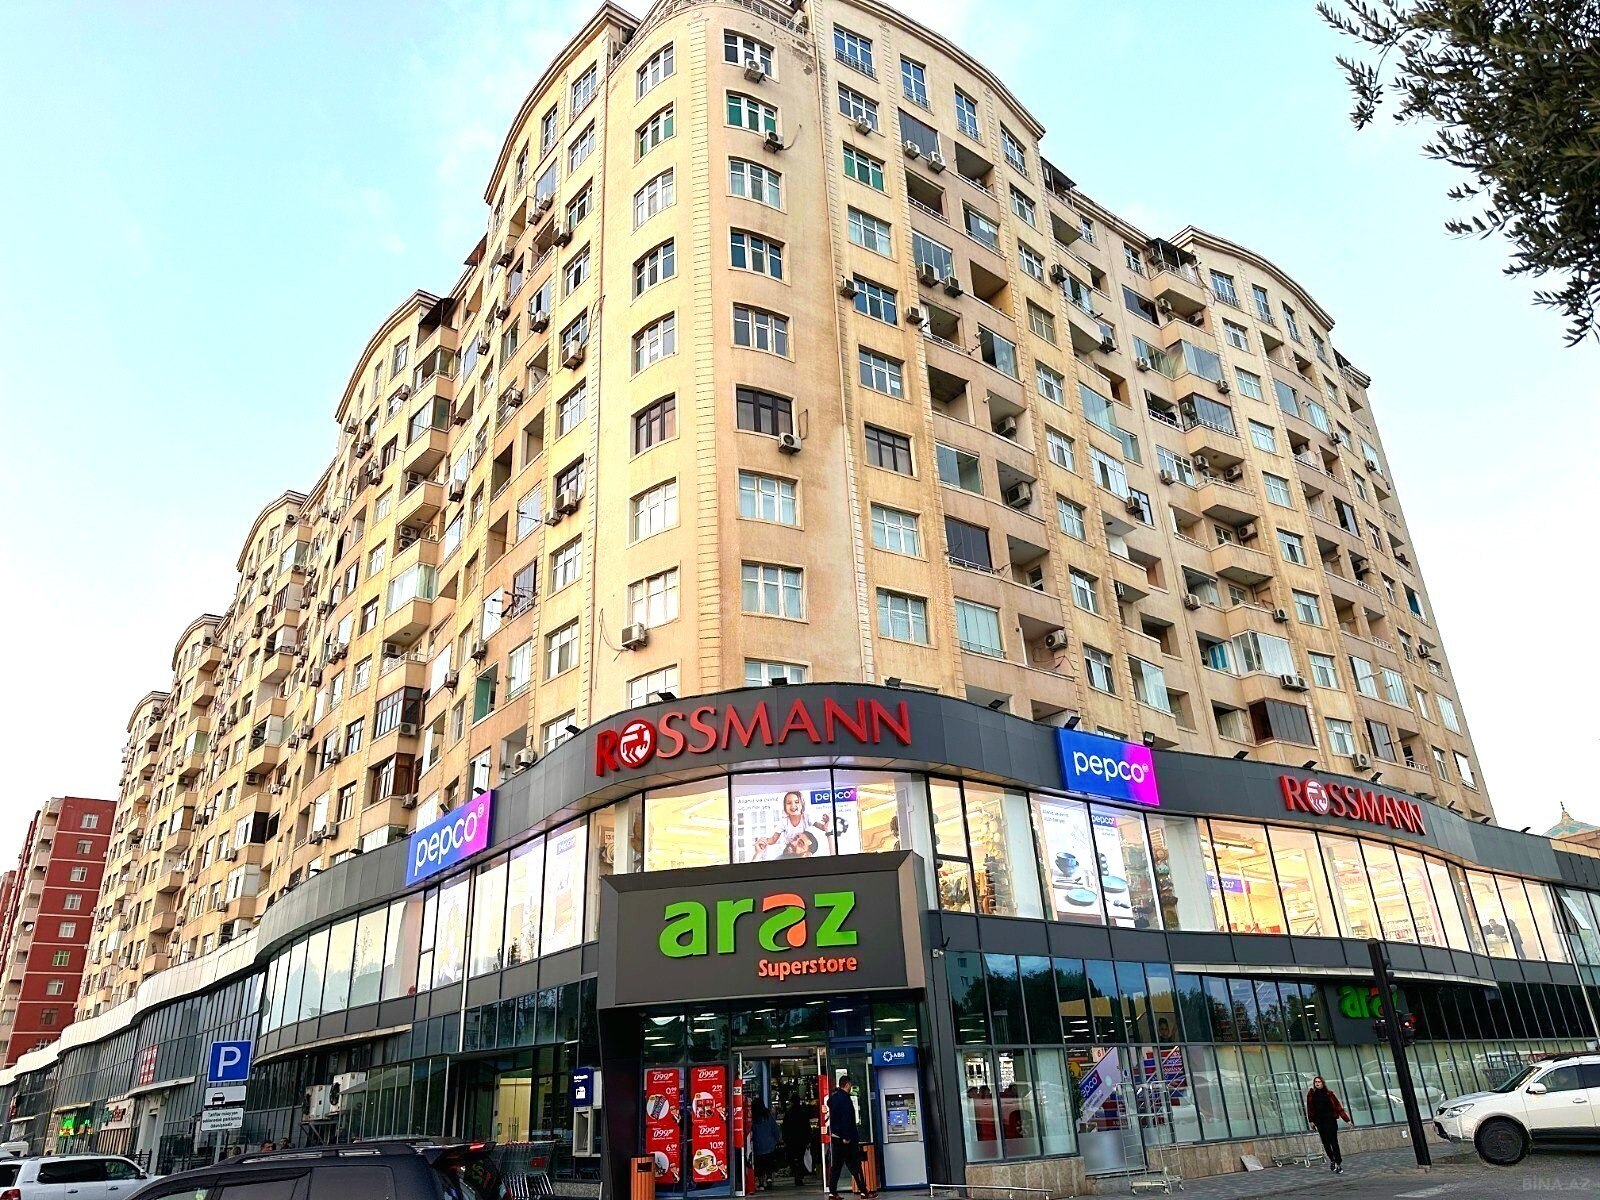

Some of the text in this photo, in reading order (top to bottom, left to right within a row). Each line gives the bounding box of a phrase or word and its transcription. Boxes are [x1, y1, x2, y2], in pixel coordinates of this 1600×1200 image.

[595, 697, 912, 777] ROSSMANN
[1073, 751, 1145, 783] pepco
[1280, 775, 1427, 836] ROSSMANN
[413, 811, 478, 877] pepco
[659, 891, 858, 958] araz
[758, 956, 858, 981] Superstore
[1338, 985, 1399, 1019] ara
[217, 1046, 242, 1078] P
